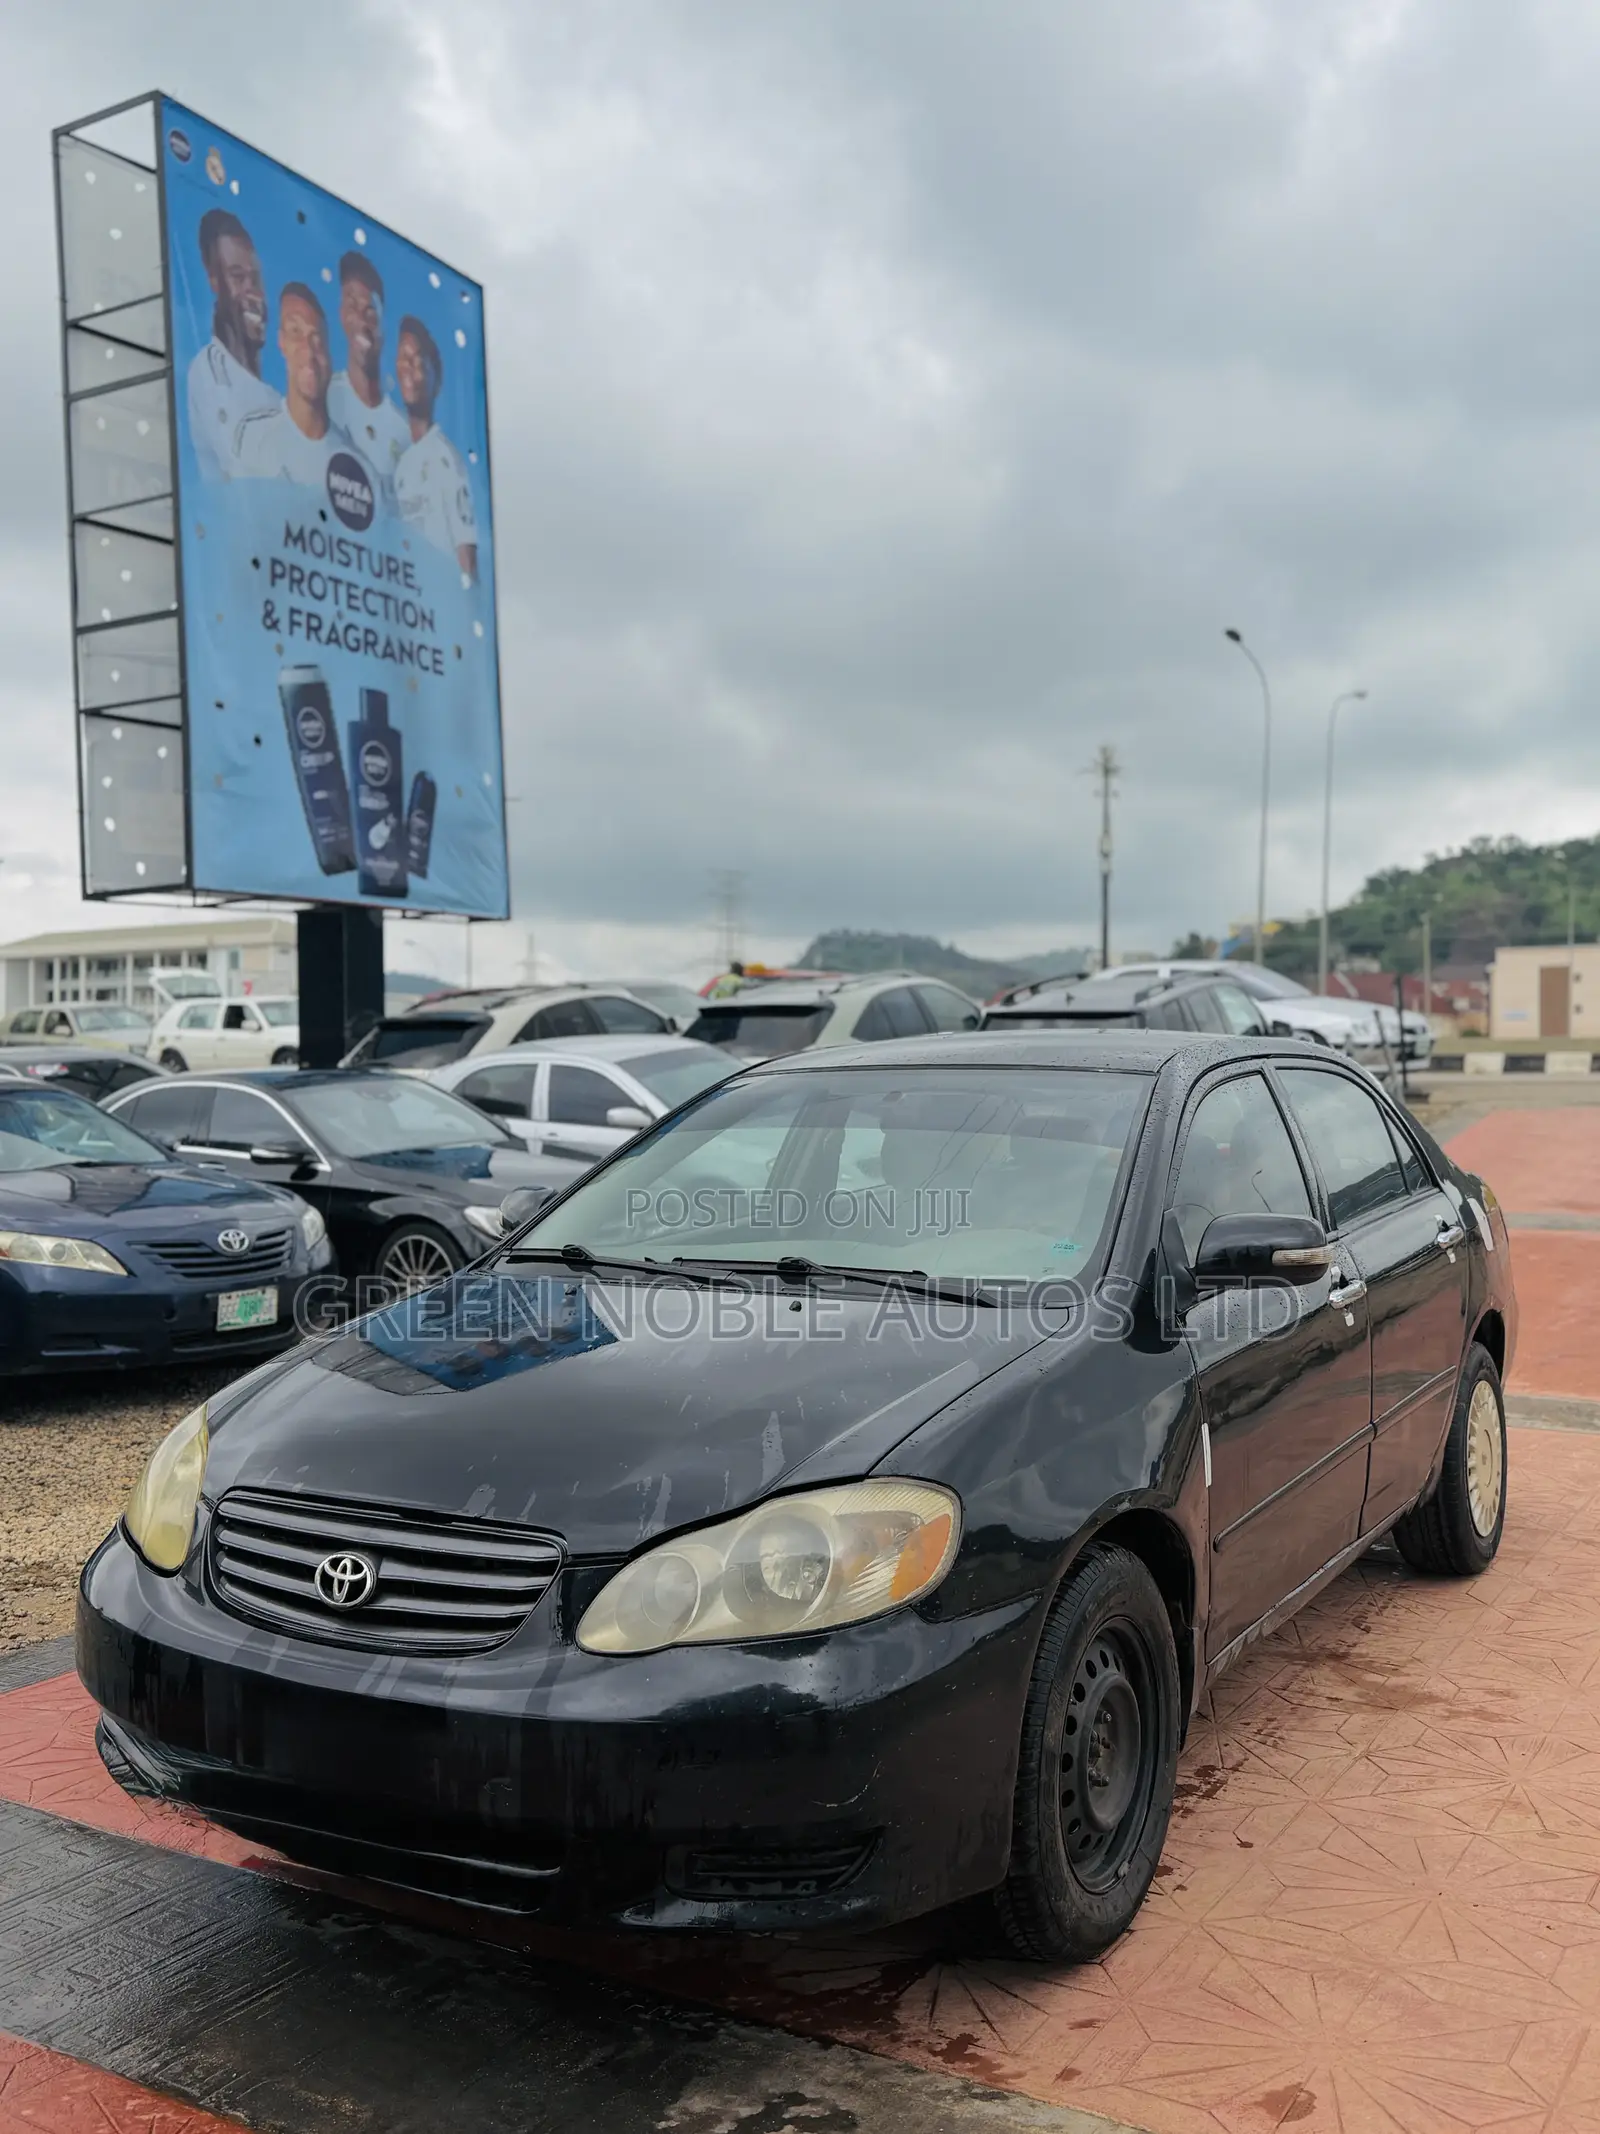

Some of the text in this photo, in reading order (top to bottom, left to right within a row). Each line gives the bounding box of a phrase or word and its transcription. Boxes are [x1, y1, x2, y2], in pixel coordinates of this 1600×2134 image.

[269, 556, 436, 634] PROTECTION
[283, 520, 422, 597] MOISTURE,
[262, 598, 445, 676] & FRAGRANCE
